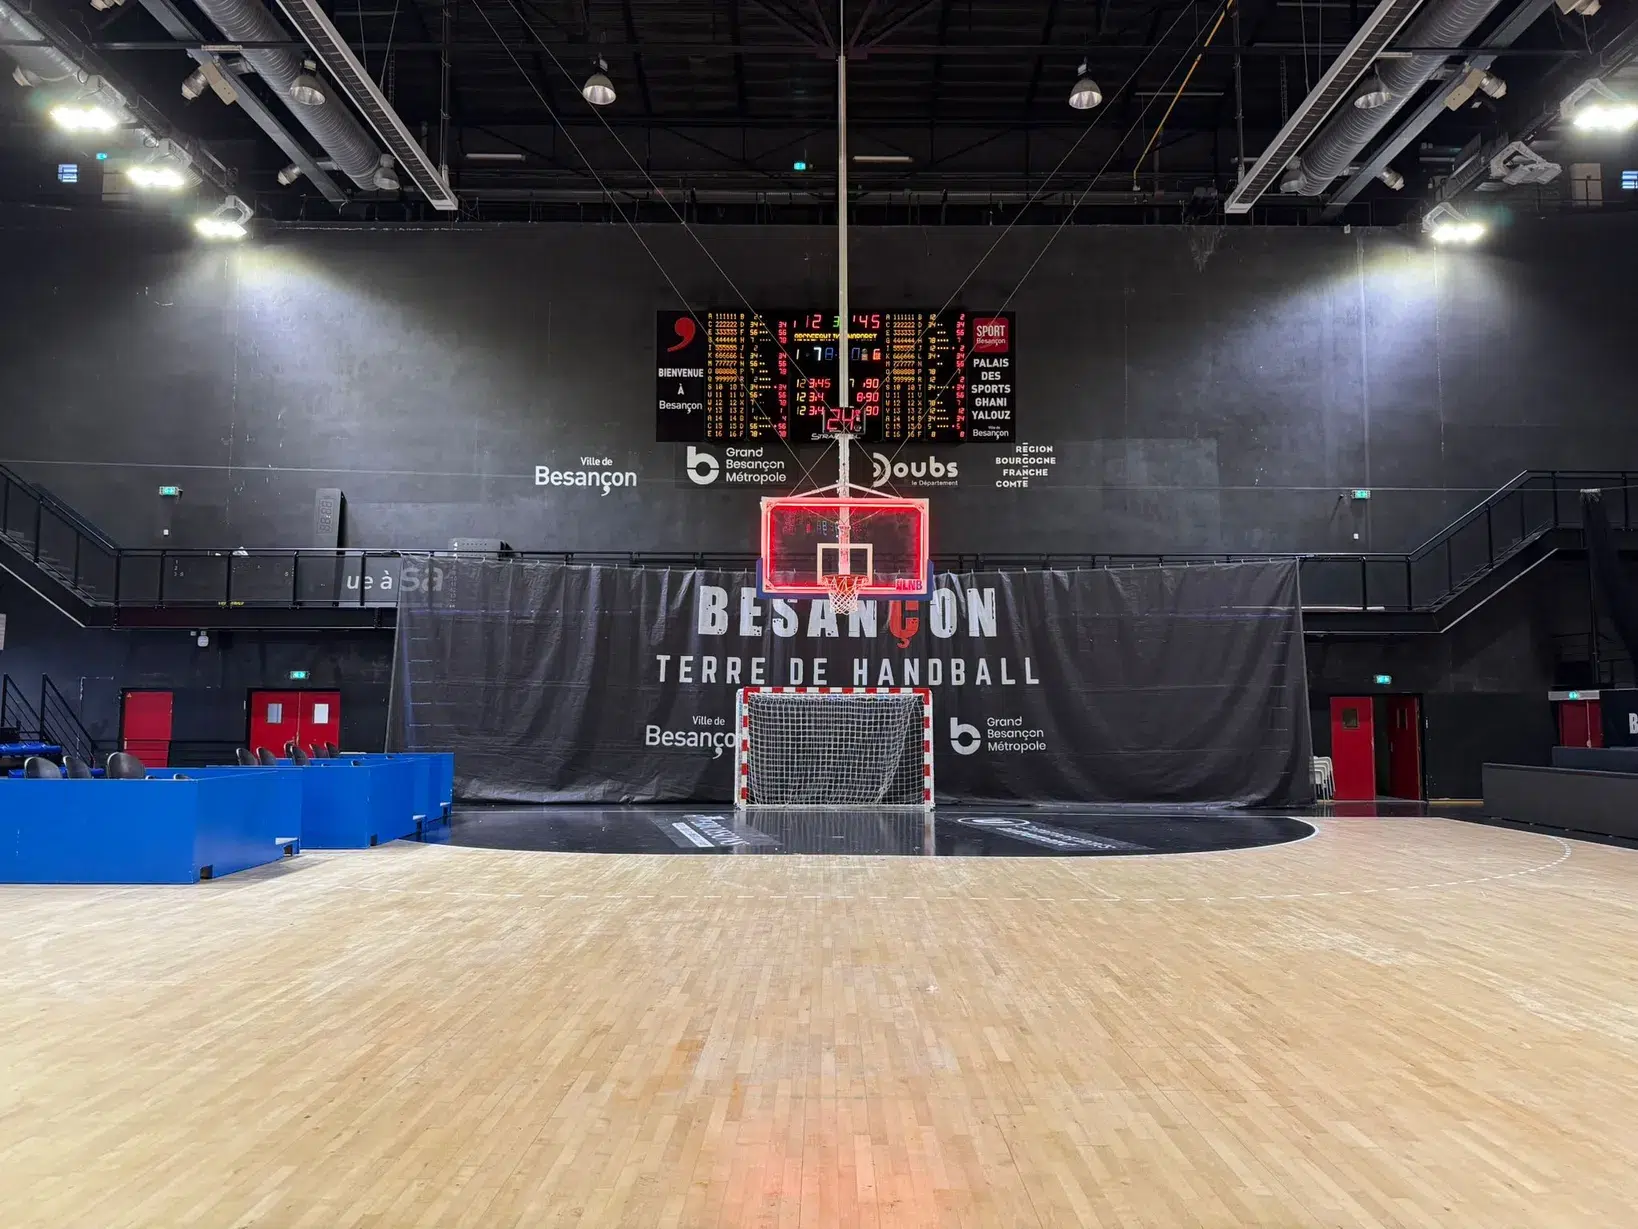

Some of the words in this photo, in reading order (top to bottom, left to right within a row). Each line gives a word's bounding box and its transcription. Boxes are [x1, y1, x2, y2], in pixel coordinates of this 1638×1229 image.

[976, 325, 1005, 336] SPORT
[973, 358, 1009, 368] PALAIS
[658, 368, 704, 378] BIENVENUE
[981, 372, 1001, 380] DES
[678, 383, 684, 395] À
[971, 384, 1011, 394] SPORTS
[659, 400, 703, 414] Besançon
[975, 398, 1007, 406] GHANI
[971, 411, 1011, 420] YALOUZ
[972, 429, 1009, 440] Besançon
[726, 447, 763, 457] Grand
[580, 456, 601, 466] Ville
[602, 457, 613, 466] de
[726, 459, 784, 471] Besançon
[535, 466, 637, 496] Besançon
[726, 472, 786, 484] Métropole
[698, 586, 997, 648] BESANÇON
[656, 654, 766, 686] TERRE
[790, 658, 828, 686] DE
[854, 657, 1040, 686] HANDBALL
[692, 716, 712, 726] Ville
[714, 717, 725, 726] de
[986, 716, 1022, 727] Grand
[988, 728, 1044, 740] Besançon
[646, 725, 736, 759] Besanço
[988, 741, 1046, 753] Métropole
